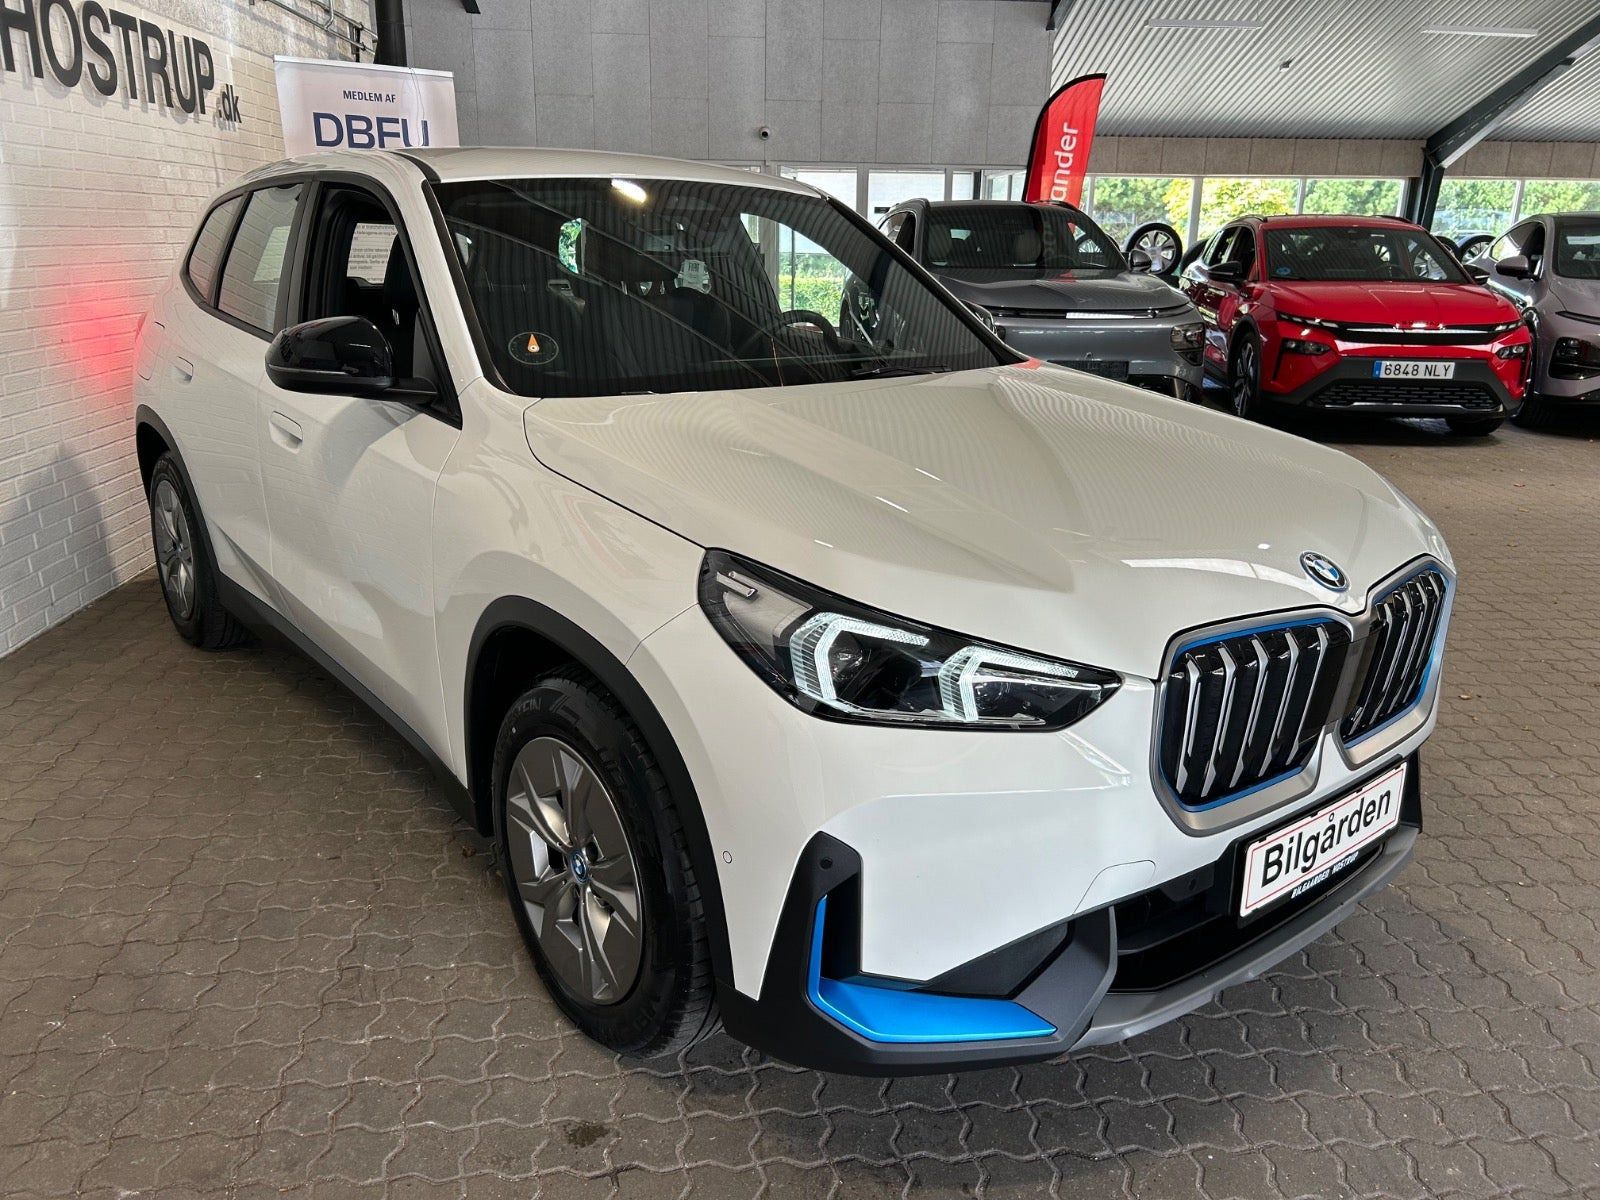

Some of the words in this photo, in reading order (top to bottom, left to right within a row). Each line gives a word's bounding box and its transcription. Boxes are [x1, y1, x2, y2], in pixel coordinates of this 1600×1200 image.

[343, 90, 383, 103] MEDLEM
[385, 94, 396, 103] AF
[312, 111, 430, 149] DBFU
[1384, 363, 1420, 377] 6848
[1423, 364, 1451, 377] NLY
[1261, 789, 1391, 888] Bilgården
